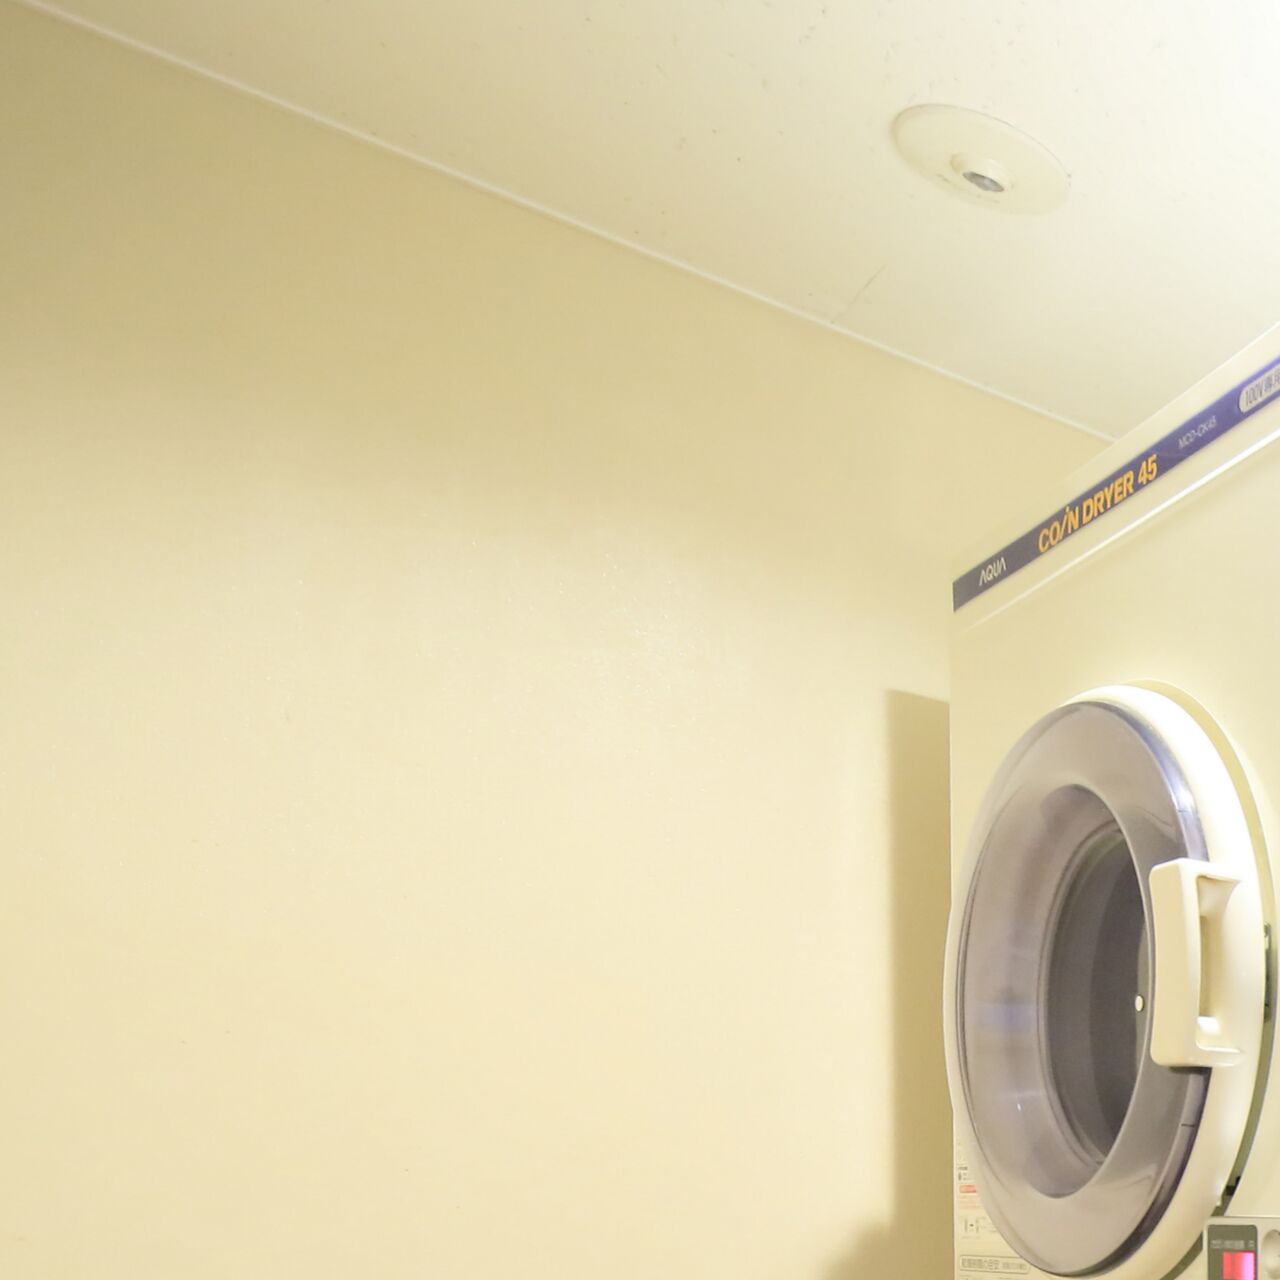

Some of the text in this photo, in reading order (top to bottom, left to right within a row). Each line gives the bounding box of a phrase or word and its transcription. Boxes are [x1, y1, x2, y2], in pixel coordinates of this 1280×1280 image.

[1082, 471, 1135, 525] DRYER
[1138, 454, 1158, 486] 45
[979, 556, 1007, 587] AQUA
